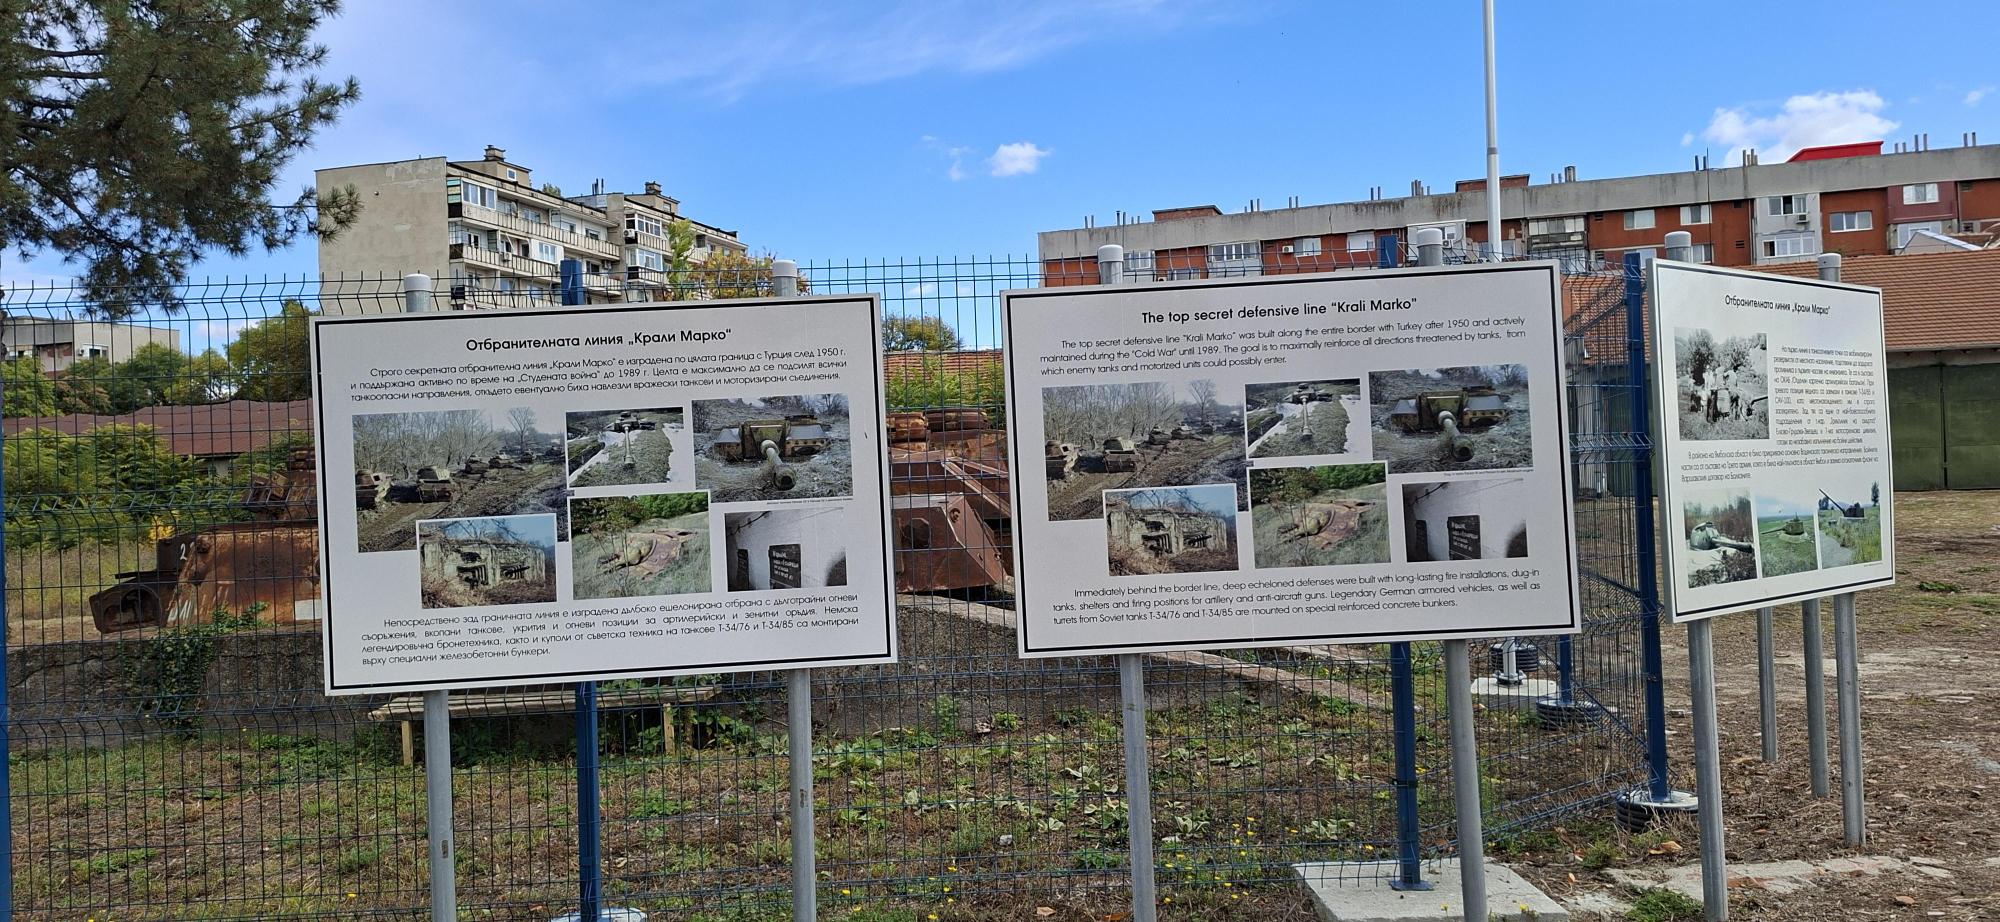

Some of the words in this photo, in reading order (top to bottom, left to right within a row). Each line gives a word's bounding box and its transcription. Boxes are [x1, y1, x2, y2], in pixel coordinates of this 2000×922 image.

[1142, 311, 1164, 323] The
[1168, 311, 1190, 324] top
[1194, 308, 1233, 321] secret
[1237, 304, 1299, 318] defensive
[1304, 303, 1326, 315] line
[466, 337, 580, 353] Отбранителната
[584, 336, 623, 346] линия
[1040, 352, 1087, 363] maintained
[1088, 352, 1115, 362] during
[1178, 346, 1195, 356] until
[1224, 344, 1238, 353] The
[1240, 343, 1260, 355] goal
[1280, 340, 1322, 350] maximally
[1324, 338, 1360, 348] reinforce
[1374, 336, 1414, 346] directions
[1416, 332, 1462, 343] threatened
[1506, 329, 1525, 338] from
[1062, 340, 1076, 349] The
[1079, 341, 1093, 349] top
[1096, 339, 1120, 347] secret
[1123, 336, 1163, 346] defensive
[1166, 335, 1180, 343] line
[1258, 329, 1275, 339] built
[1278, 328, 1302, 339] along
[1321, 327, 1344, 335] entire
[1347, 324, 1375, 334] border
[1378, 323, 1394, 332] with
[1398, 322, 1422, 332] Turkey
[1425, 320, 1444, 330] after
[1448, 318, 1469, 328] 1950
[1492, 316, 1525, 326] actively
[359, 380, 415, 390] поддържана
[418, 378, 453, 387] активно
[471, 376, 500, 386] време
[619, 368, 641, 377] 1989
[653, 367, 679, 377] Целта
[691, 365, 746, 374] максимално
[778, 362, 815, 371] подсилят
[818, 361, 847, 369] всички
[370, 368, 402, 378] Строго
[404, 366, 456, 377] секретната
[458, 363, 521, 374] отбранителна
[522, 362, 547, 370] линия
[626, 357, 673, 366] изградена
[688, 355, 716, 363] цялата
[718, 353, 754, 363] граница
[764, 350, 792, 361] Турция
[794, 350, 815, 358] след
[817, 347, 838, 357] 1950
[1041, 366, 1064, 375] which
[1067, 367, 1096, 375] enemy
[1097, 363, 1119, 373] tanks
[1140, 360, 1181, 371] motorized
[1203, 357, 1227, 368] could
[1229, 356, 1262, 368] possibly
[351, 393, 409, 402] танкоопасни
[474, 388, 512, 396] откъдето
[514, 385, 565, 395] евентуално
[567, 382, 589, 392] биха
[591, 382, 631, 390] навлезли
[634, 380, 677, 390] вражески
[680, 379, 713, 387] танкови
[724, 375, 787, 386] моторизирани
[1074, 587, 1125, 597] Immediately
[1127, 584, 1157, 595] behind
[1174, 583, 1202, 592] border
[1222, 581, 1246, 591] deep
[1248, 578, 1294, 589] echeloned
[1296, 577, 1334, 587] defenses
[1358, 575, 1376, 584] built
[1377, 574, 1393, 583] with
[1395, 573, 1444, 584] long-lasting
[1445, 571, 1458, 580] fire
[1511, 568, 1539, 579] dug-in
[1080, 601, 1110, 610] shelters
[1132, 598, 1151, 610] firing
[1154, 598, 1189, 608] positions
[1204, 595, 1234, 605] artillery
[1256, 591, 1302, 602] anti-aircraft
[1330, 588, 1376, 601] Legendary
[1379, 587, 1415, 597] German
[1418, 584, 1455, 594] armored
[1510, 581, 1527, 590] well
[384, 616, 460, 628] Непосредствено
[481, 613, 532, 624] граничната
[534, 611, 559, 619] линия
[572, 608, 618, 618] изградена
[621, 604, 657, 615] дълбоко
[659, 602, 722, 612] ешелонирана
[724, 598, 762, 609] отбрана
[774, 595, 826, 606] дълготрайни
[828, 594, 857, 602] огневи
[424, 629, 461, 637] вкопани
[512, 624, 546, 634] укрития
[565, 621, 595, 629] огневи
[602, 619, 638, 627] позиции
[662, 612, 725, 625] артилерийски
[745, 610, 778, 619] зенитни
[824, 606, 858, 614] Немска
[1054, 617, 1077, 625] turrets
[1079, 614, 1097, 623] from
[1100, 613, 1124, 623] Soviet
[1126, 612, 1147, 621] tanks
[1252, 605, 1290, 615] mounted
[1305, 603, 1336, 615] special
[1338, 601, 1380, 611] reinforced
[1382, 601, 1420, 610] concrete
[506, 637, 529, 645] както
[542, 635, 571, 644] куполи
[586, 631, 626, 640] съветска
[629, 629, 663, 637] техника
[681, 626, 715, 635] танкове
[811, 618, 859, 628] монтирани
[362, 657, 387, 666] върху
[388, 654, 437, 663] специални
[439, 649, 509, 660] железобетонни
